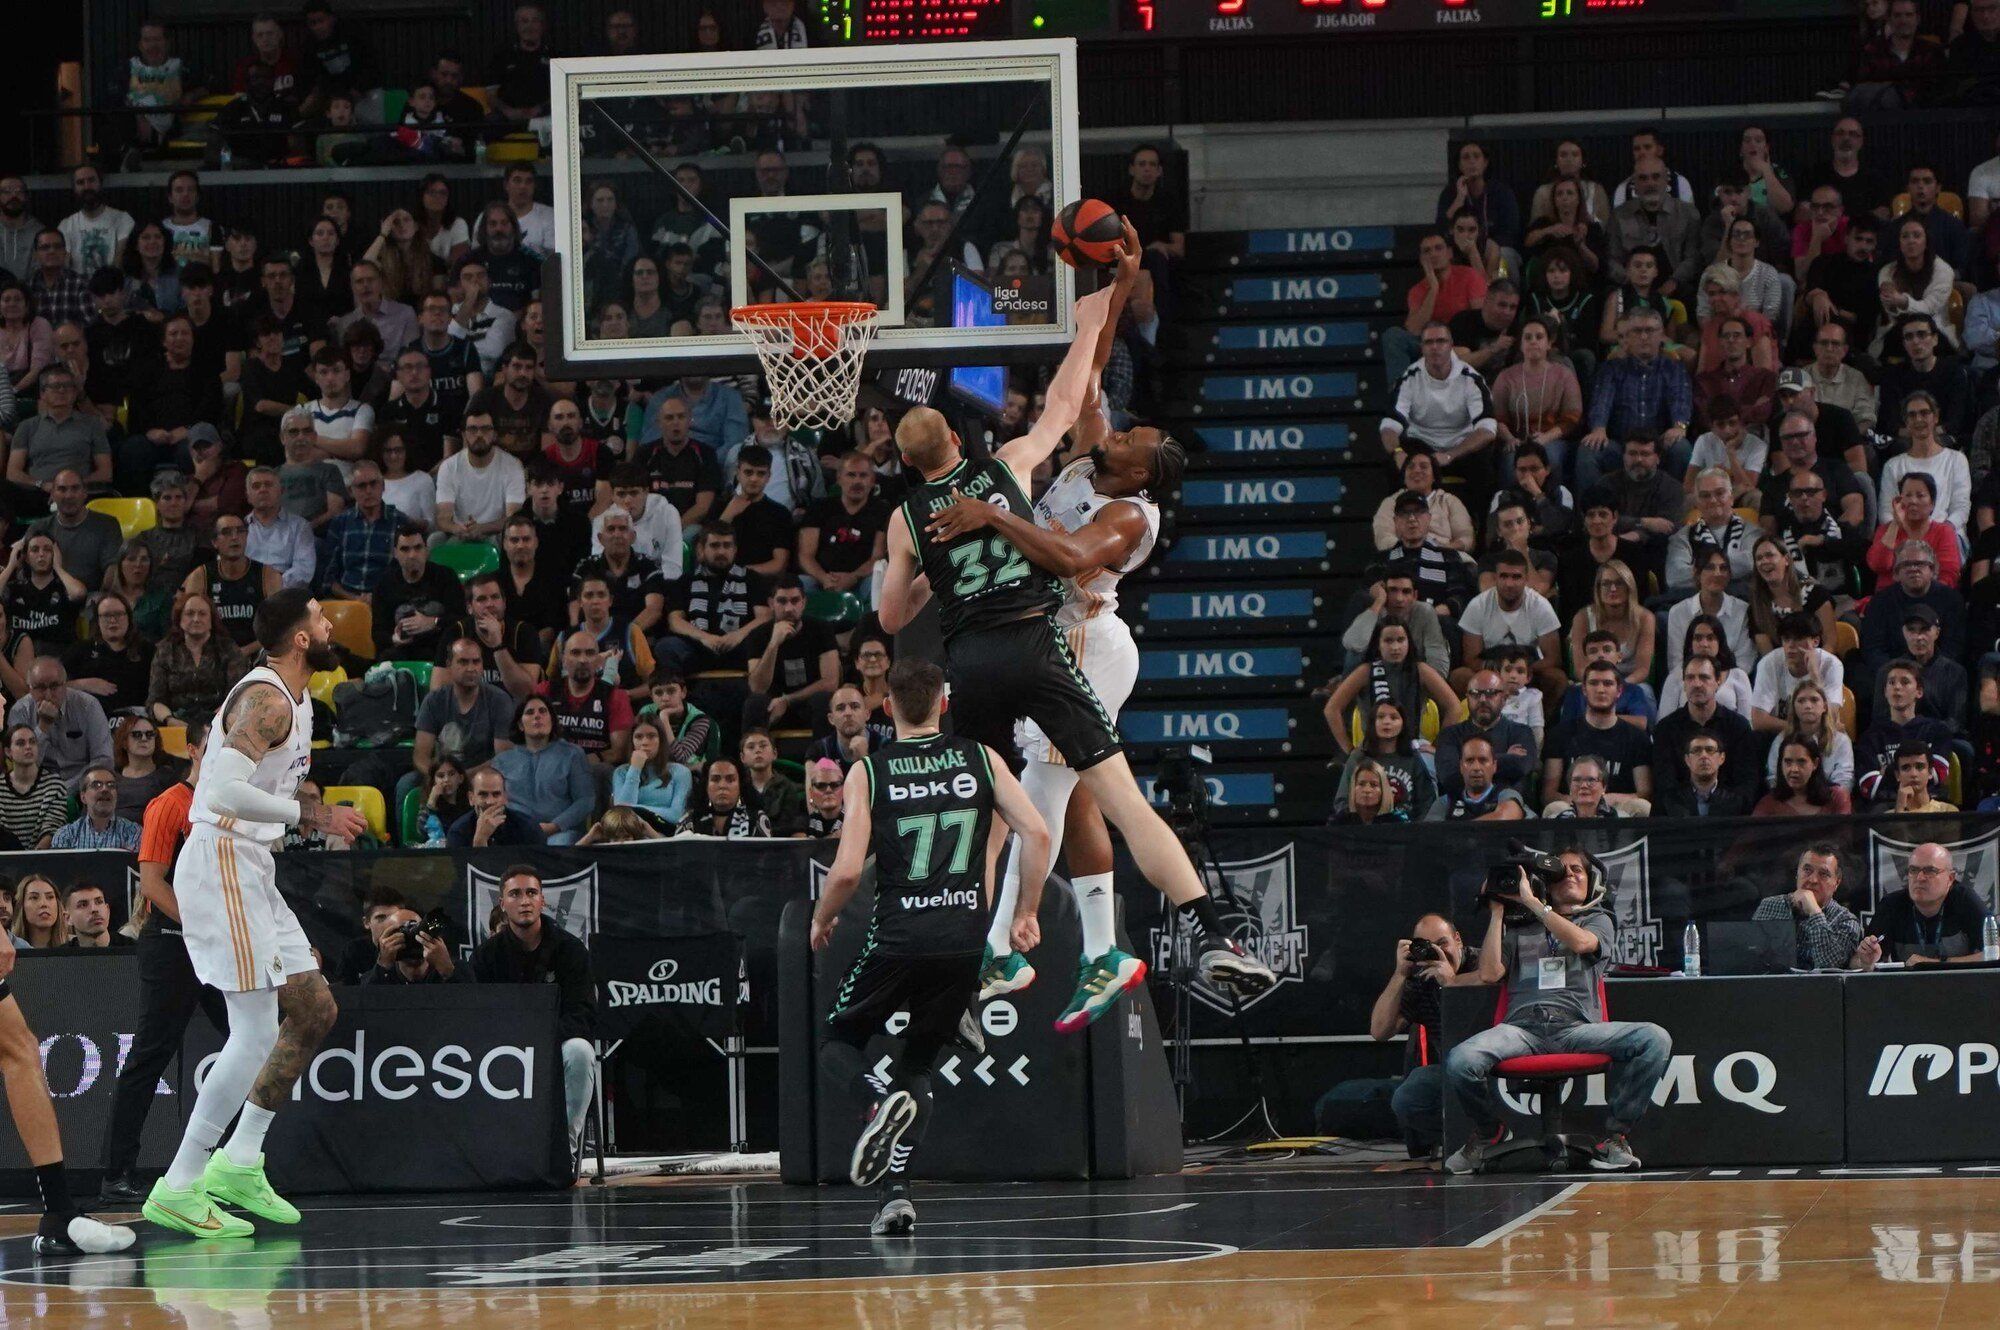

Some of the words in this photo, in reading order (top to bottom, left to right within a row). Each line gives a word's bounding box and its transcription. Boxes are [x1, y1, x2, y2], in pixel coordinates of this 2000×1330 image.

[1209, 16, 1254, 31] FALTAS
[1315, 13, 1376, 28] JUGADOR
[1436, 9, 1481, 23] FALTAS
[1287, 230, 1353, 251] IMQ
[994, 286, 1019, 300] liga
[1272, 277, 1339, 300] IMQ
[994, 299, 1048, 311] endesa
[1258, 325, 1327, 348] IMQ
[1244, 376, 1314, 399] IMQ
[1234, 427, 1304, 450] IMQ
[1224, 480, 1296, 504] IMQ
[1207, 536, 1281, 559] IMQ
[949, 533, 1031, 597] 32
[217, 604, 254, 618] BILBAO
[1191, 593, 1266, 618] IMQ
[1178, 652, 1258, 676] IMQ
[1163, 712, 1244, 739] IMQ
[888, 748, 968, 775] KULLAMÄE
[889, 781, 950, 801] bbk
[896, 808, 978, 881] 77
[900, 883, 979, 910] vueling
[607, 977, 723, 1008] SPALDING
